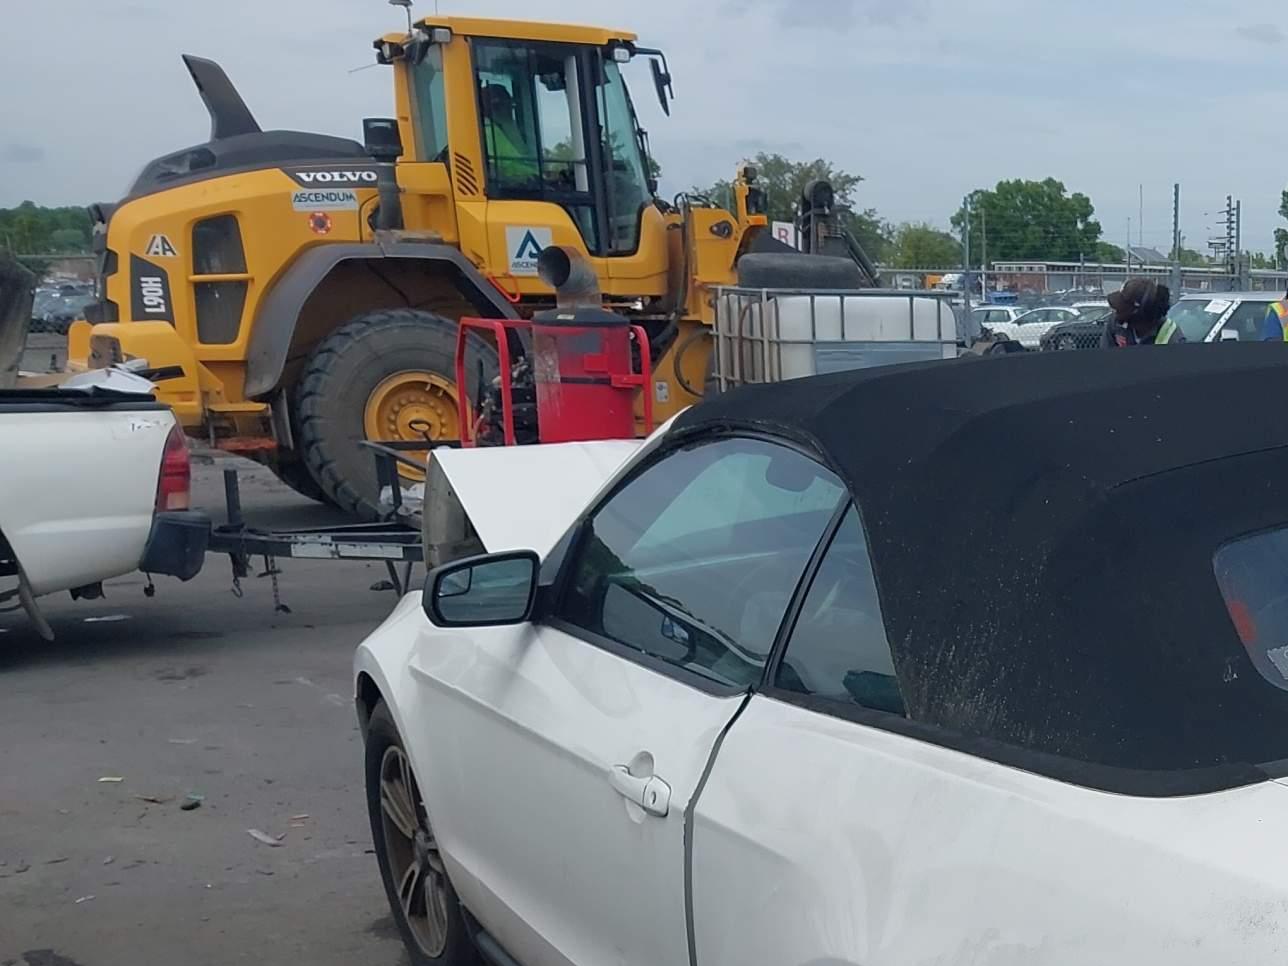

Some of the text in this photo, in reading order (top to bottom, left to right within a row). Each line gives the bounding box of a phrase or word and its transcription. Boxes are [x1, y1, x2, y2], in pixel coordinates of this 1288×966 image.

[296, 171, 377, 183] VOLVO
[292, 190, 356, 204] ASCENDUM
[139, 276, 167, 313] L90H
